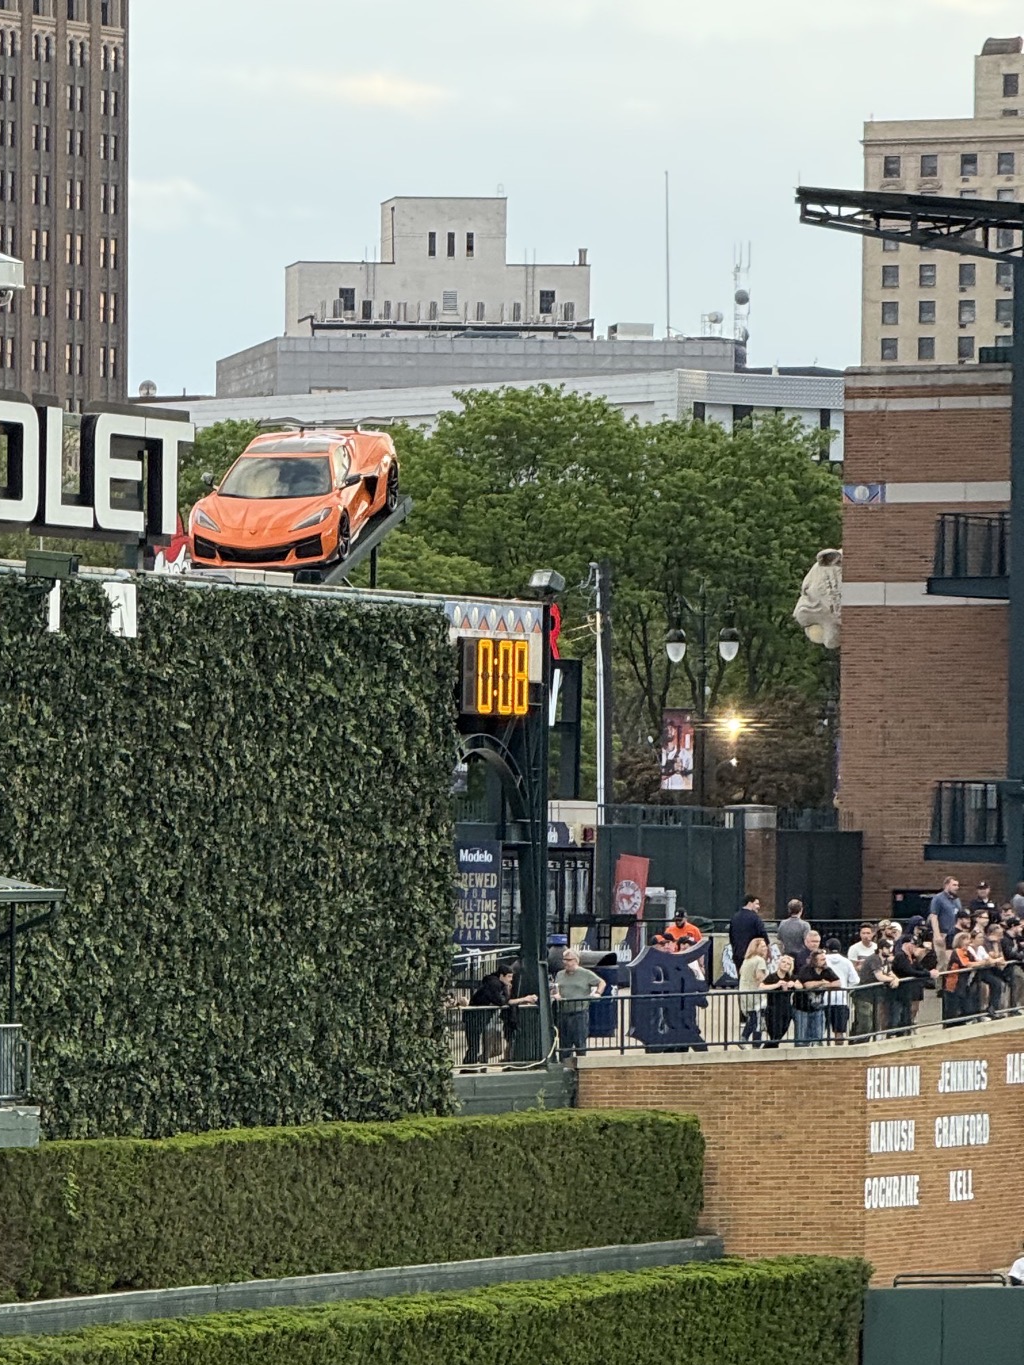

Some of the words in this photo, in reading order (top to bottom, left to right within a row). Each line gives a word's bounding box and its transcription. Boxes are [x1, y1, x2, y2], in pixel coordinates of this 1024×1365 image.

[477, 638, 529, 715] 0:08
[459, 848, 493, 863] Modelo
[464, 889, 487, 899] FOR
[459, 930, 491, 941] FANS
[866, 1065, 921, 1099] HEILMANN
[937, 1060, 988, 1093] JENNINGS
[870, 1119, 915, 1153] MANUSH
[934, 1113, 990, 1148] CRAWFORD
[864, 1174, 920, 1209] COCHRANE
[949, 1169, 974, 1201] KELL
